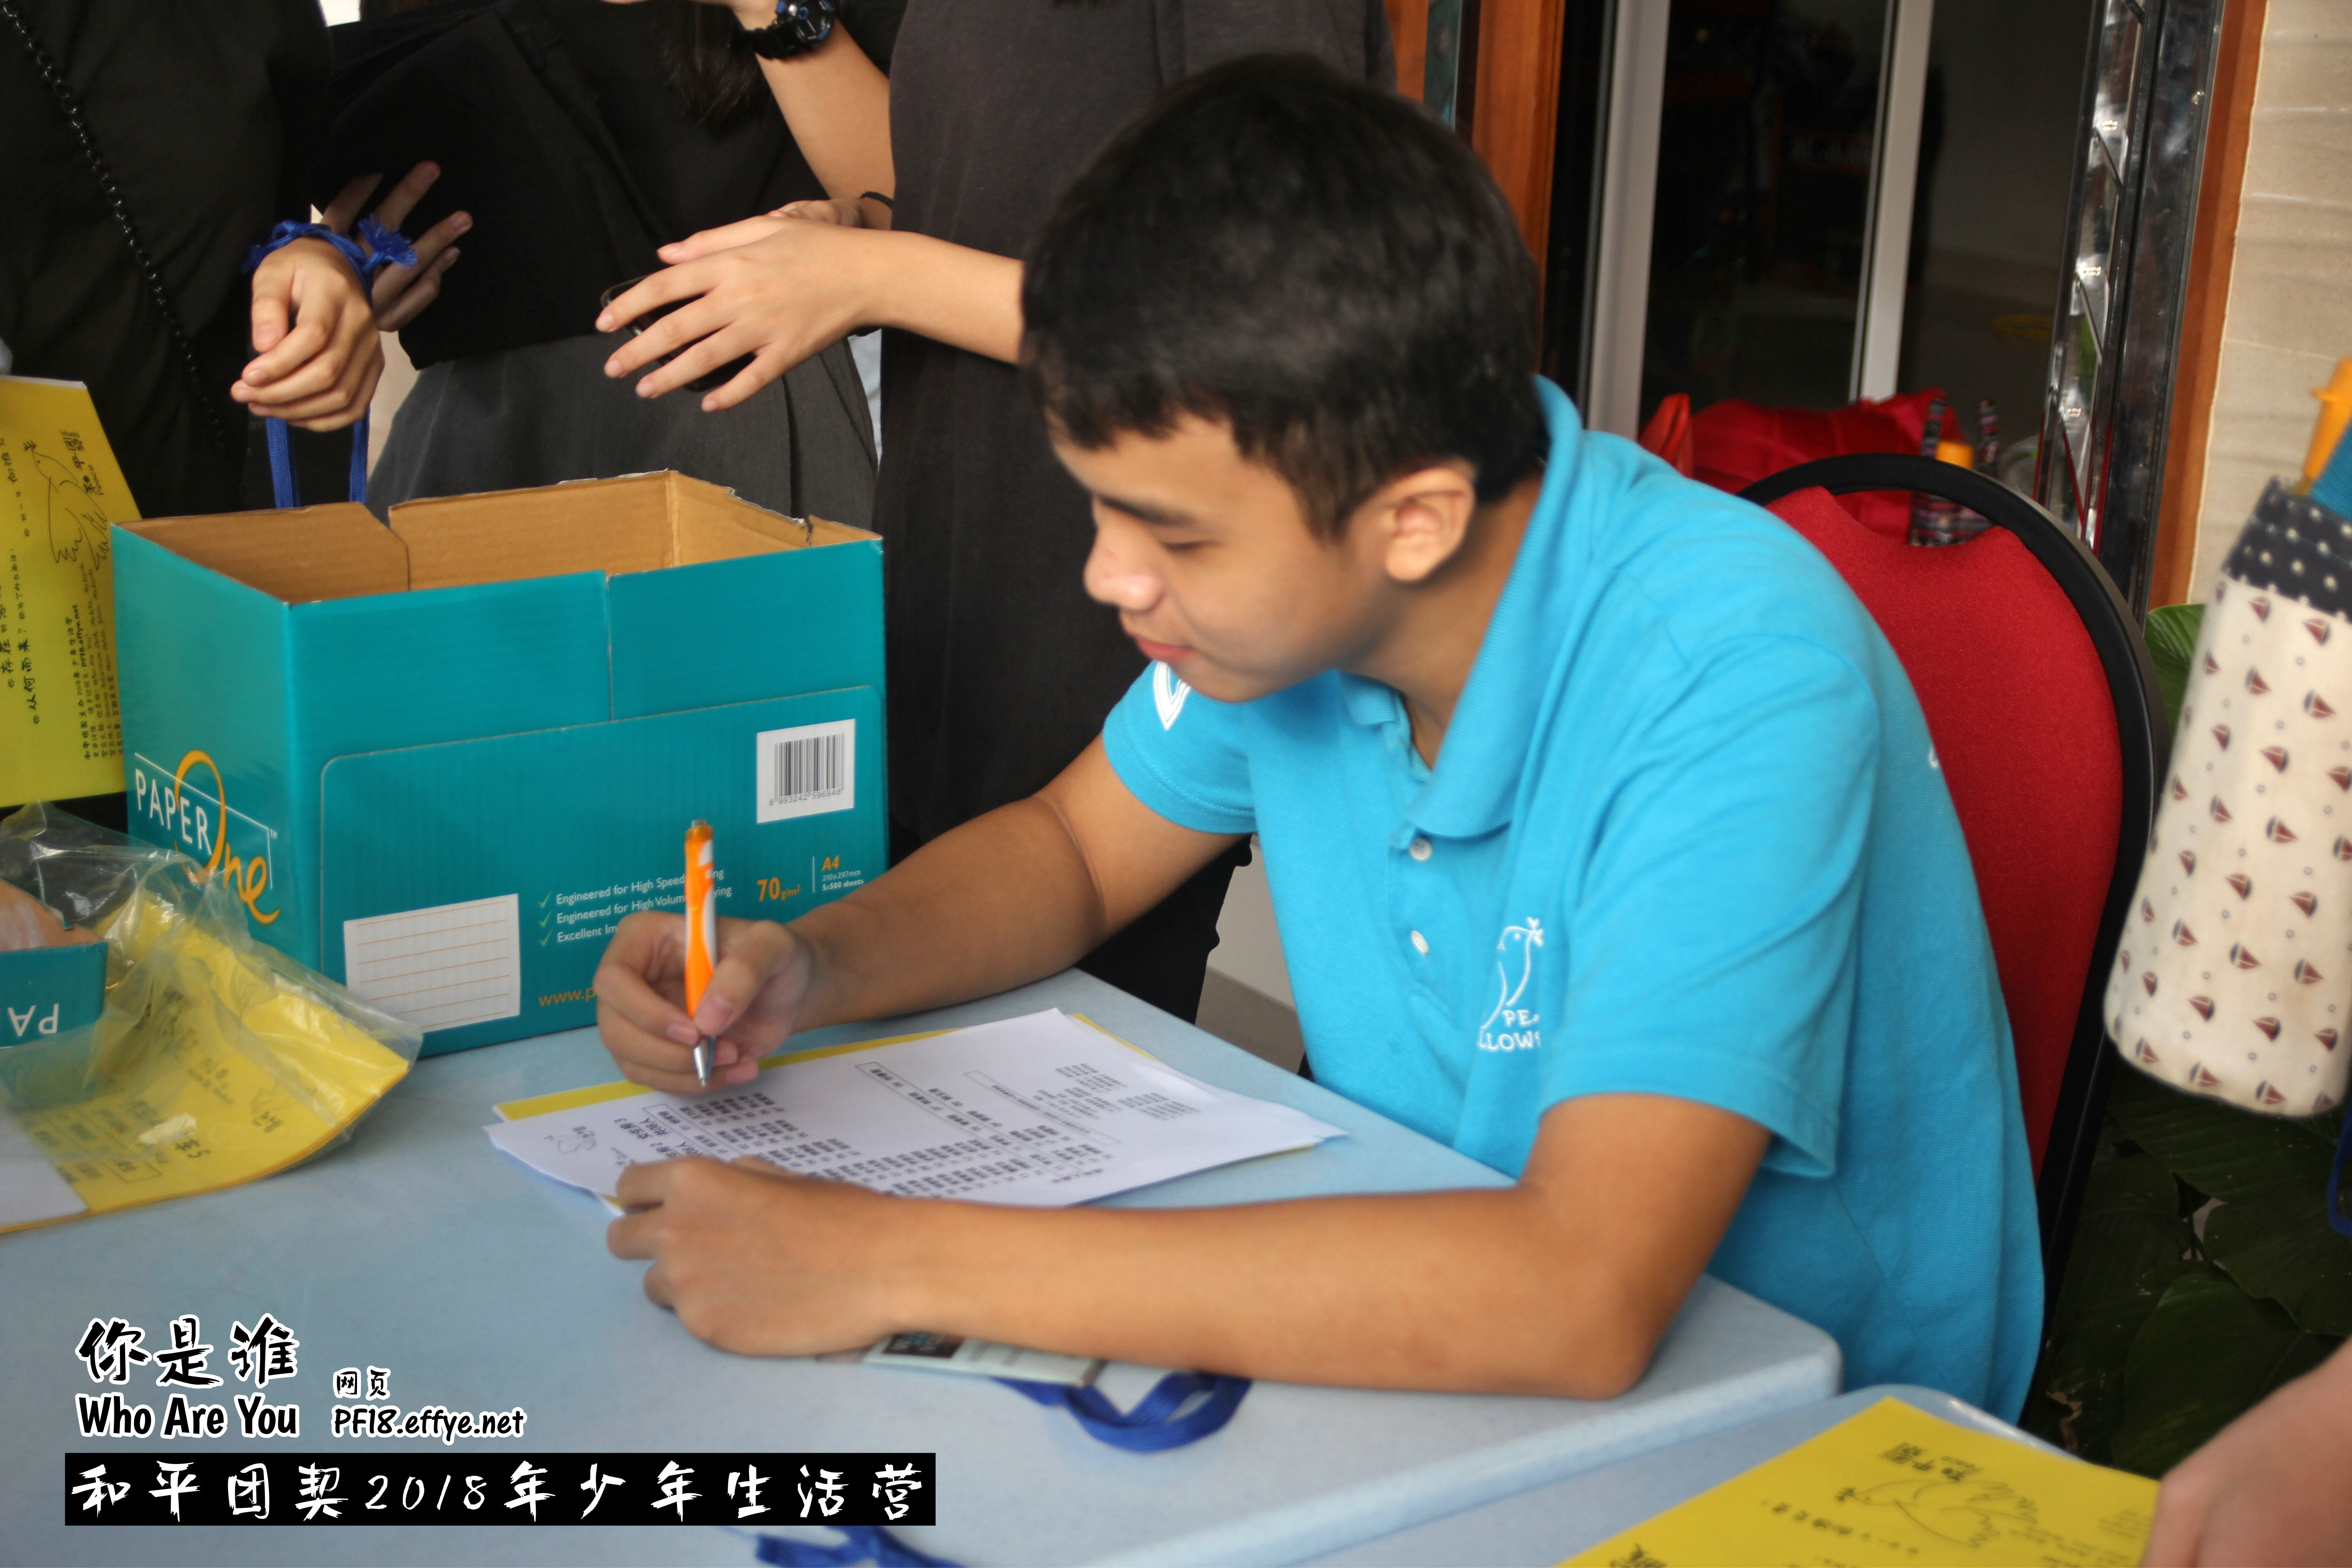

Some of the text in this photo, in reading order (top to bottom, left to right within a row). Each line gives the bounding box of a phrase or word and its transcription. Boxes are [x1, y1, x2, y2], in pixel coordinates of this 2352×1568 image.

[135, 768, 213, 856] PAPER
[821, 855, 840, 871] A4
[556, 874, 685, 906] Engineered for High Speed
[756, 876, 781, 902] 70
[822, 879, 864, 891] 5x500 sheets
[557, 906, 612, 925] Engineered
[614, 903, 629, 914] for
[631, 898, 654, 911] High
[655, 894, 686, 908] Volum
[557, 927, 603, 943] Excellent
[539, 986, 596, 1006] www.p
